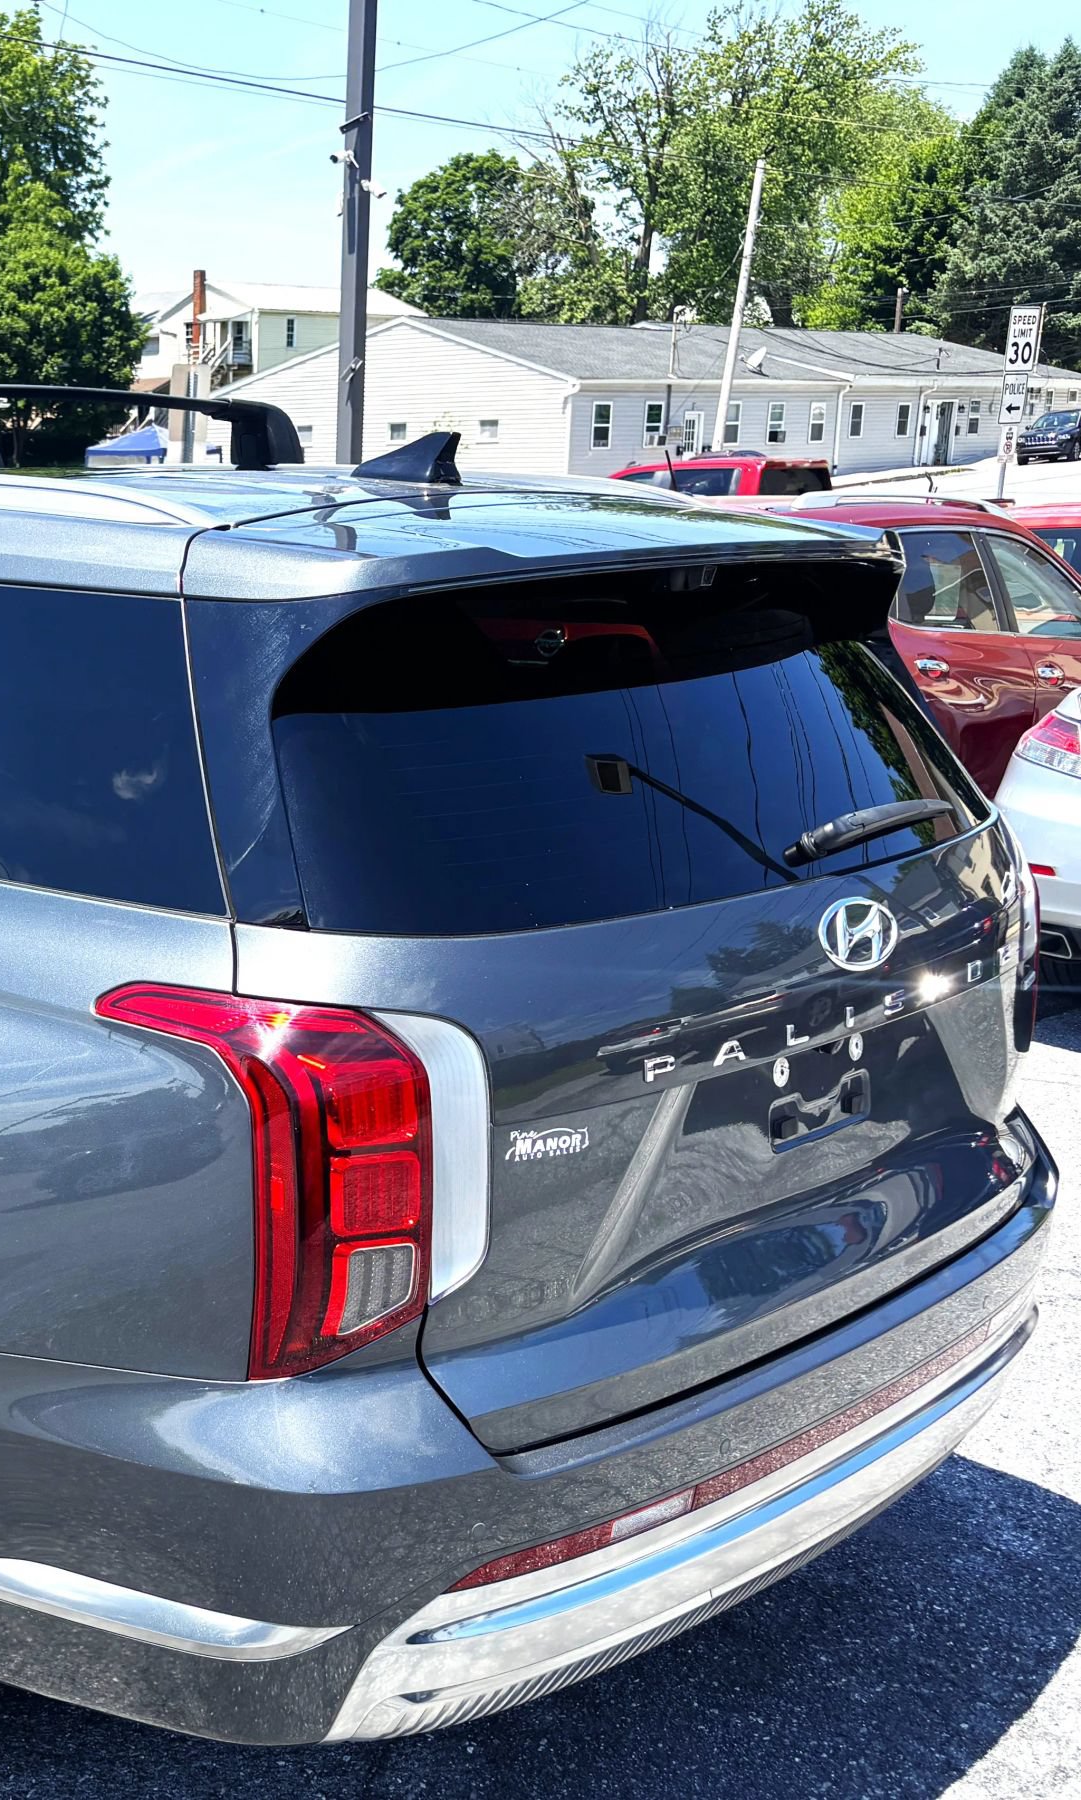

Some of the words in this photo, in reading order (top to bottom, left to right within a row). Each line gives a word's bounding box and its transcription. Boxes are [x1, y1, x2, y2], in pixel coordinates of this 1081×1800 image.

[1012, 315, 1037, 326] SPEED
[1012, 328, 1033, 338] LIMIT
[1008, 341, 1032, 365] 30
[1004, 382, 1026, 395] POLICE
[643, 943, 1012, 1083] PALISDE
[510, 1129, 538, 1141] Pine
[515, 1133, 582, 1155] MANOR
[514, 1152, 542, 1162] AUTO
[549, 1145, 581, 1157] SALES
